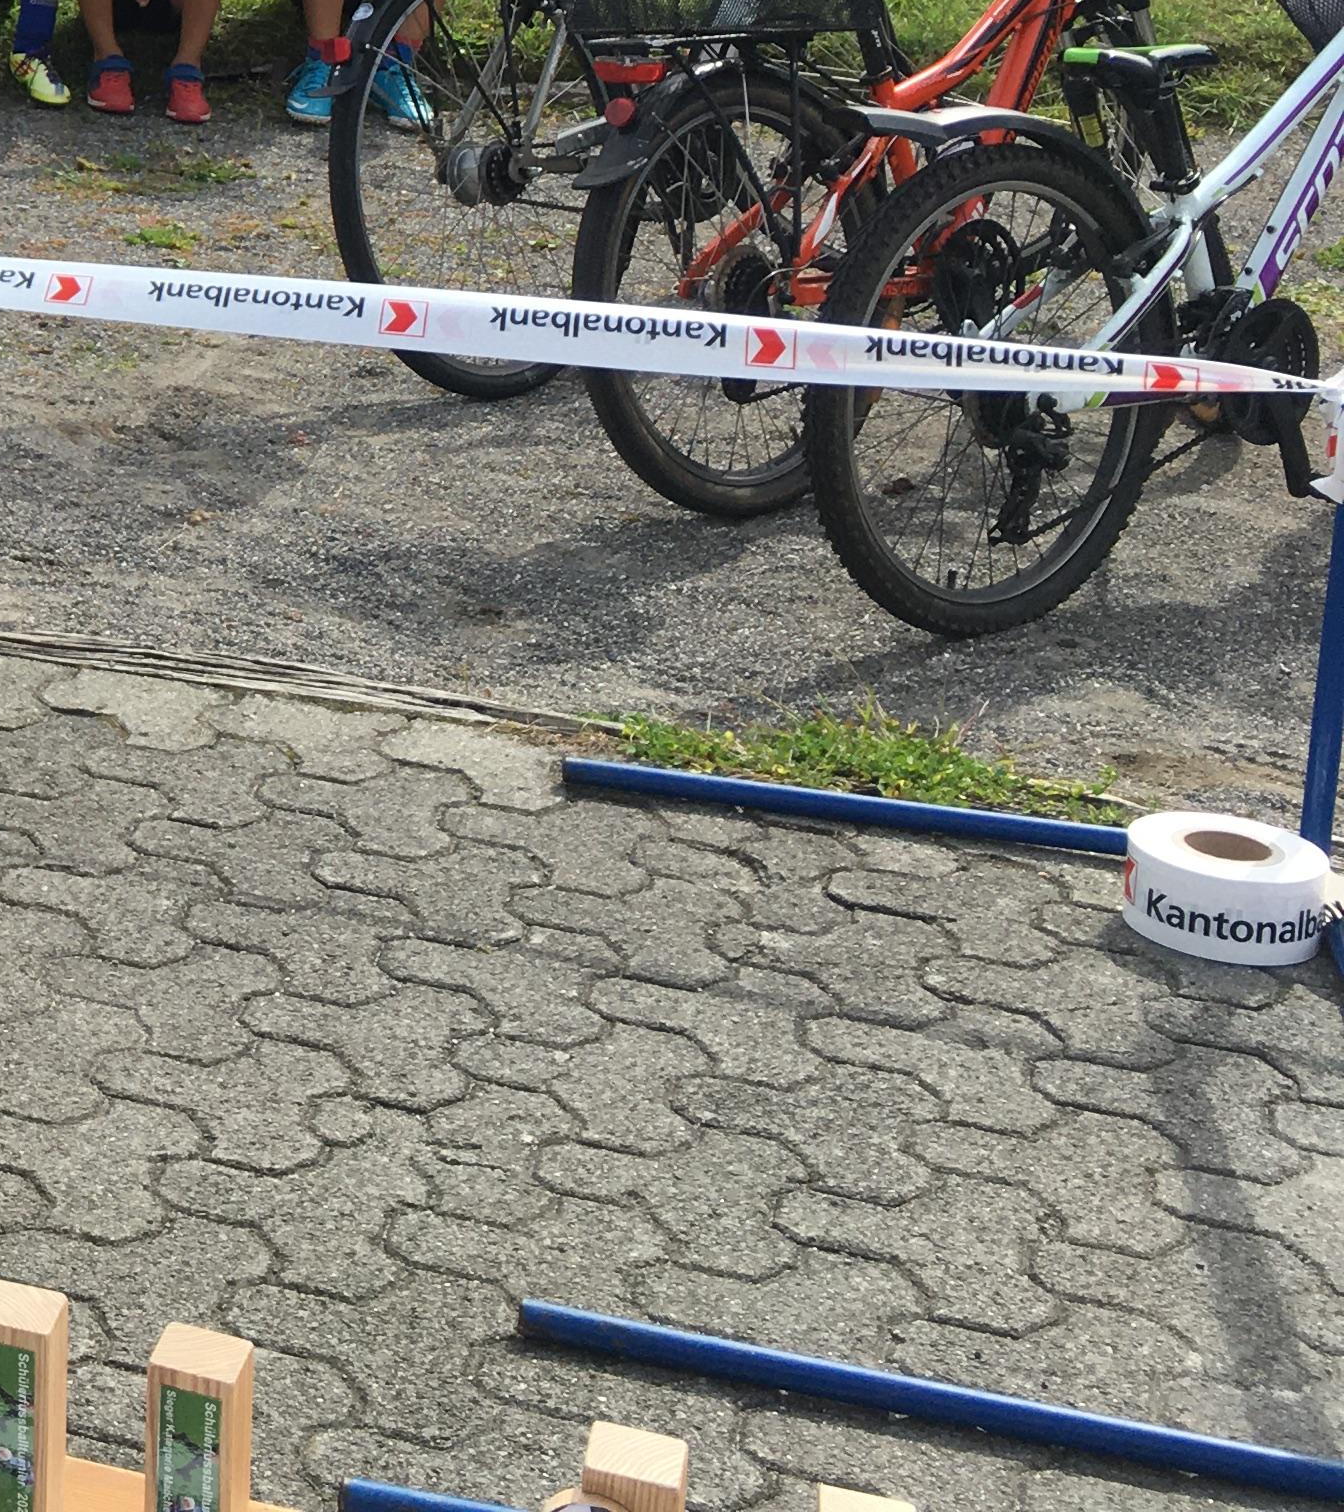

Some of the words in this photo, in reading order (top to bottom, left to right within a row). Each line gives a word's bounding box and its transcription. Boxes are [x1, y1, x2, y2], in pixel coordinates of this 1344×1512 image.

[147, 280, 365, 318] Kantonalbank
[488, 305, 727, 349] Kantonalbank
[864, 334, 1125, 377] Kantonalbank
[17, 1352, 30, 1486] Schülerfussballturnier
[164, 1390, 176, 1422] Sieger
[163, 1424, 175, 1473] Kategorie
